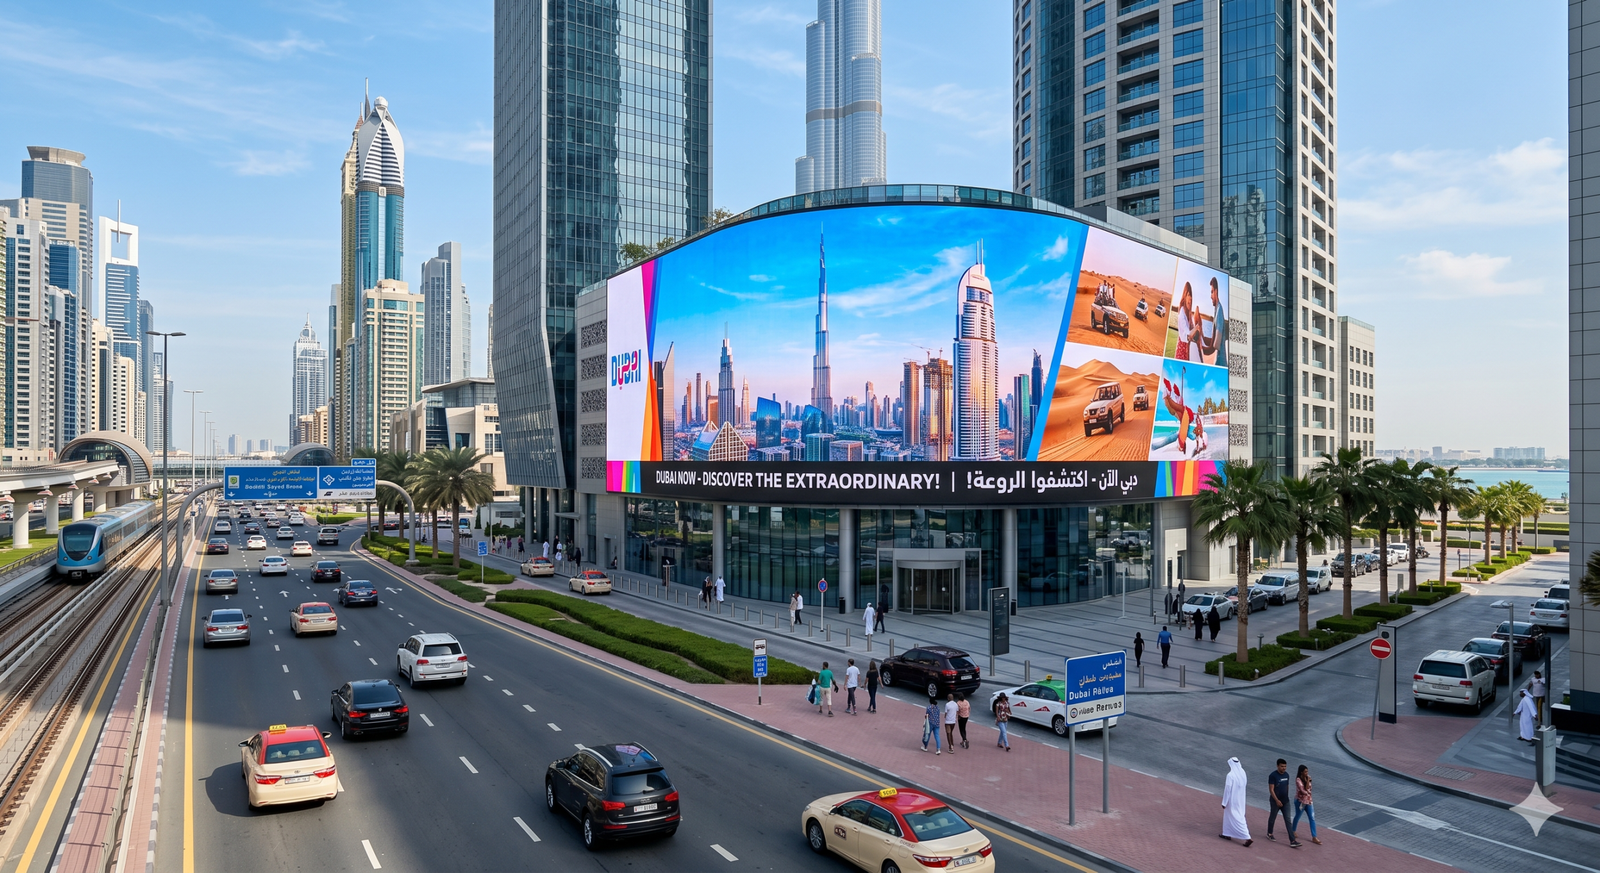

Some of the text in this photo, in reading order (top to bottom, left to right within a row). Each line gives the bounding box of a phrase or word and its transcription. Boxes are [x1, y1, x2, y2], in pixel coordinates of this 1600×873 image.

[656, 470, 677, 485] DUBAI
[678, 471, 697, 485] NOW
[702, 471, 753, 488] DISCOVER
[755, 473, 783, 489] THE
[786, 472, 940, 490] EXTRAORDINARY!
[966, 470, 1026, 494] الروعة!
[1031, 468, 1088, 494] اكتشفوا
[1098, 469, 1118, 491] الآن
[1120, 474, 1138, 495] دبي
[1069, 688, 1091, 701] Dubai
